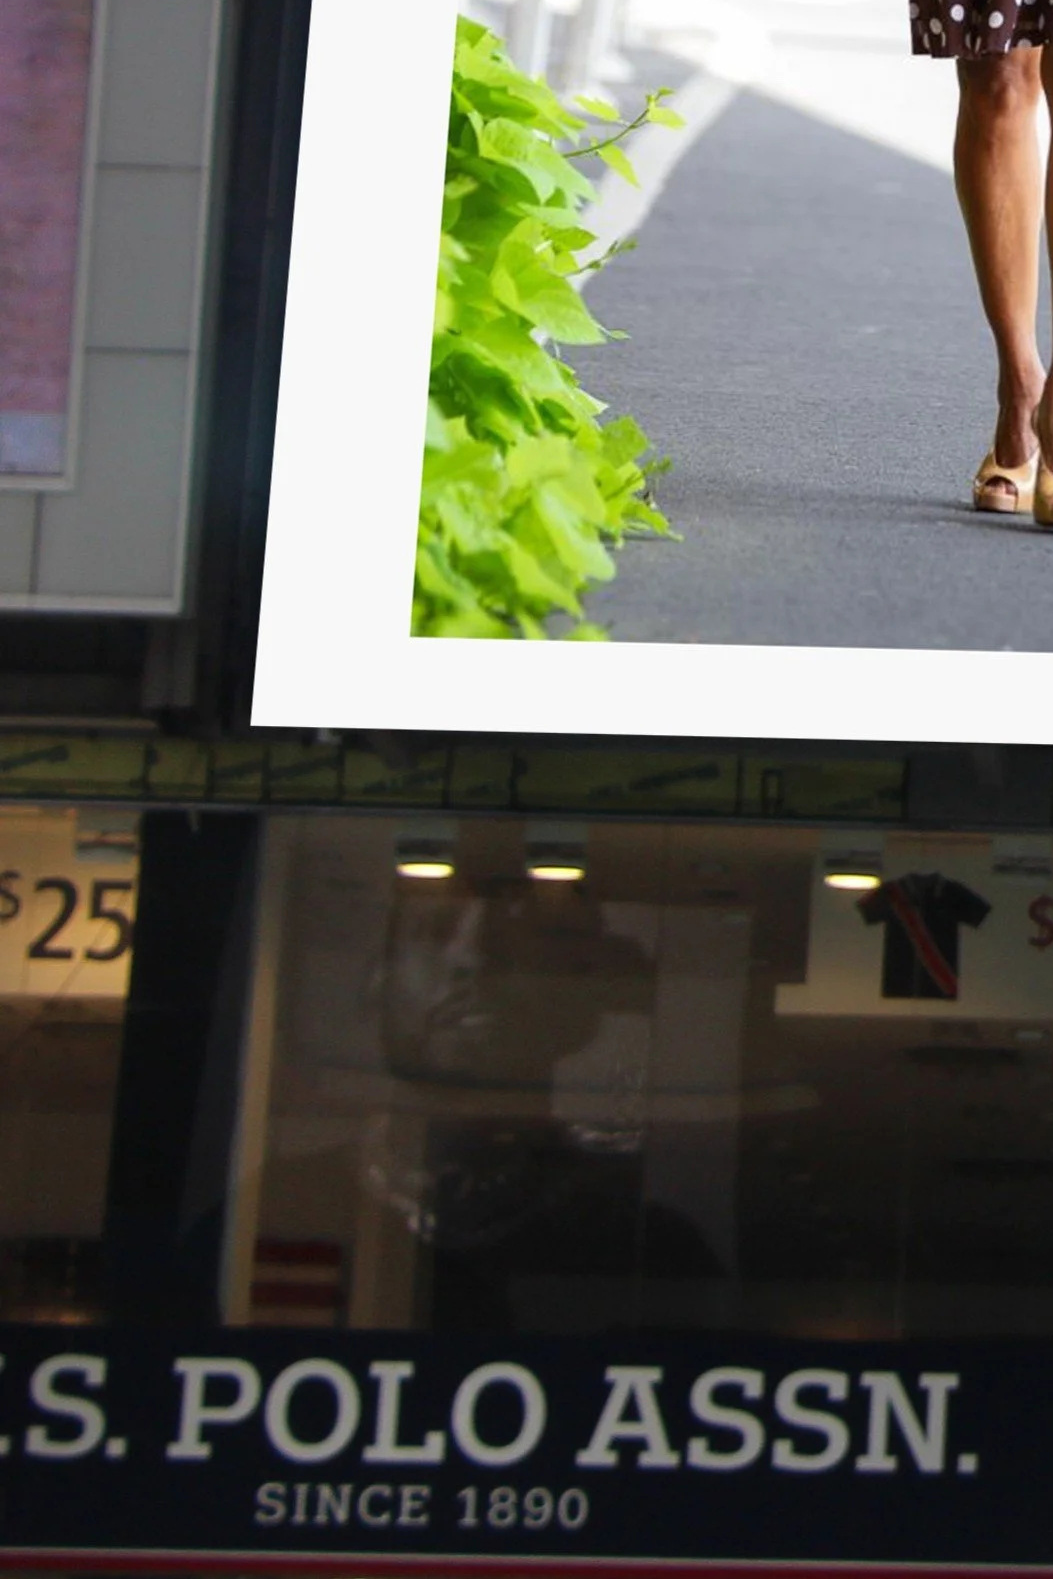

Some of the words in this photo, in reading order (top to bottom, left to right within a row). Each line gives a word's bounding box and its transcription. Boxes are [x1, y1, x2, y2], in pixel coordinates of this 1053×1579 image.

[167, 1358, 546, 1465] POLO
[576, 1366, 977, 1473] ASSN.
[256, 1483, 429, 1525] SINCE
[459, 1487, 587, 1527] 1890
